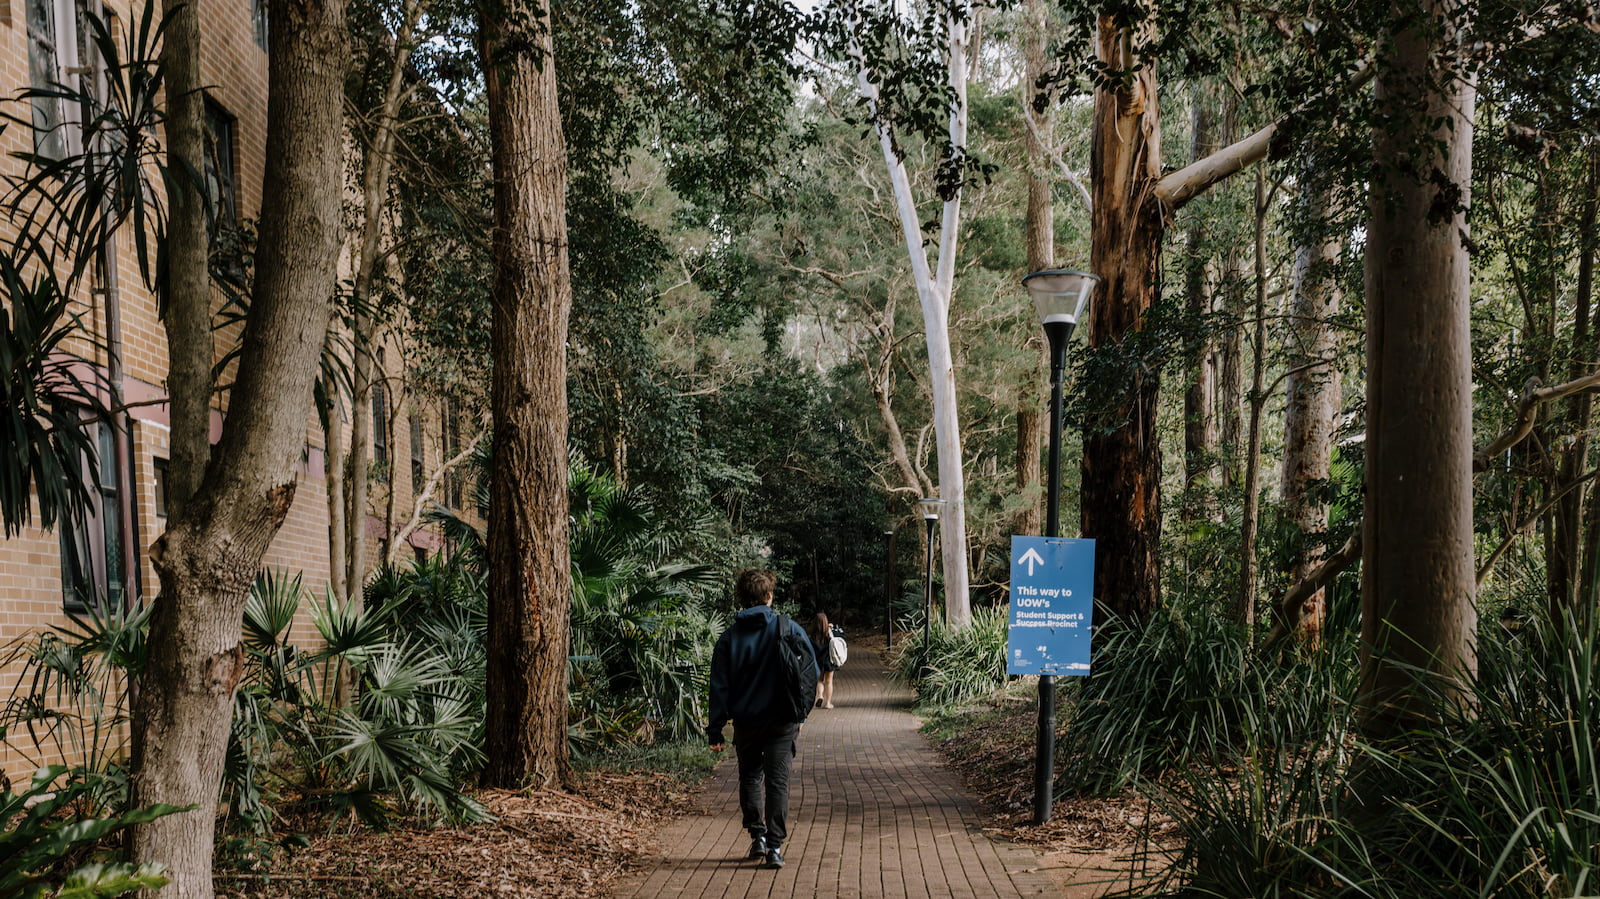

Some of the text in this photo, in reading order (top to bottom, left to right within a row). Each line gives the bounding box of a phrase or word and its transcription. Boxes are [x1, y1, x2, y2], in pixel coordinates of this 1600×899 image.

[1017, 586, 1072, 598] This way to
[1017, 598, 1050, 608] UOW's
[1016, 611, 1046, 619] Student
[1047, 612, 1077, 621] Support
